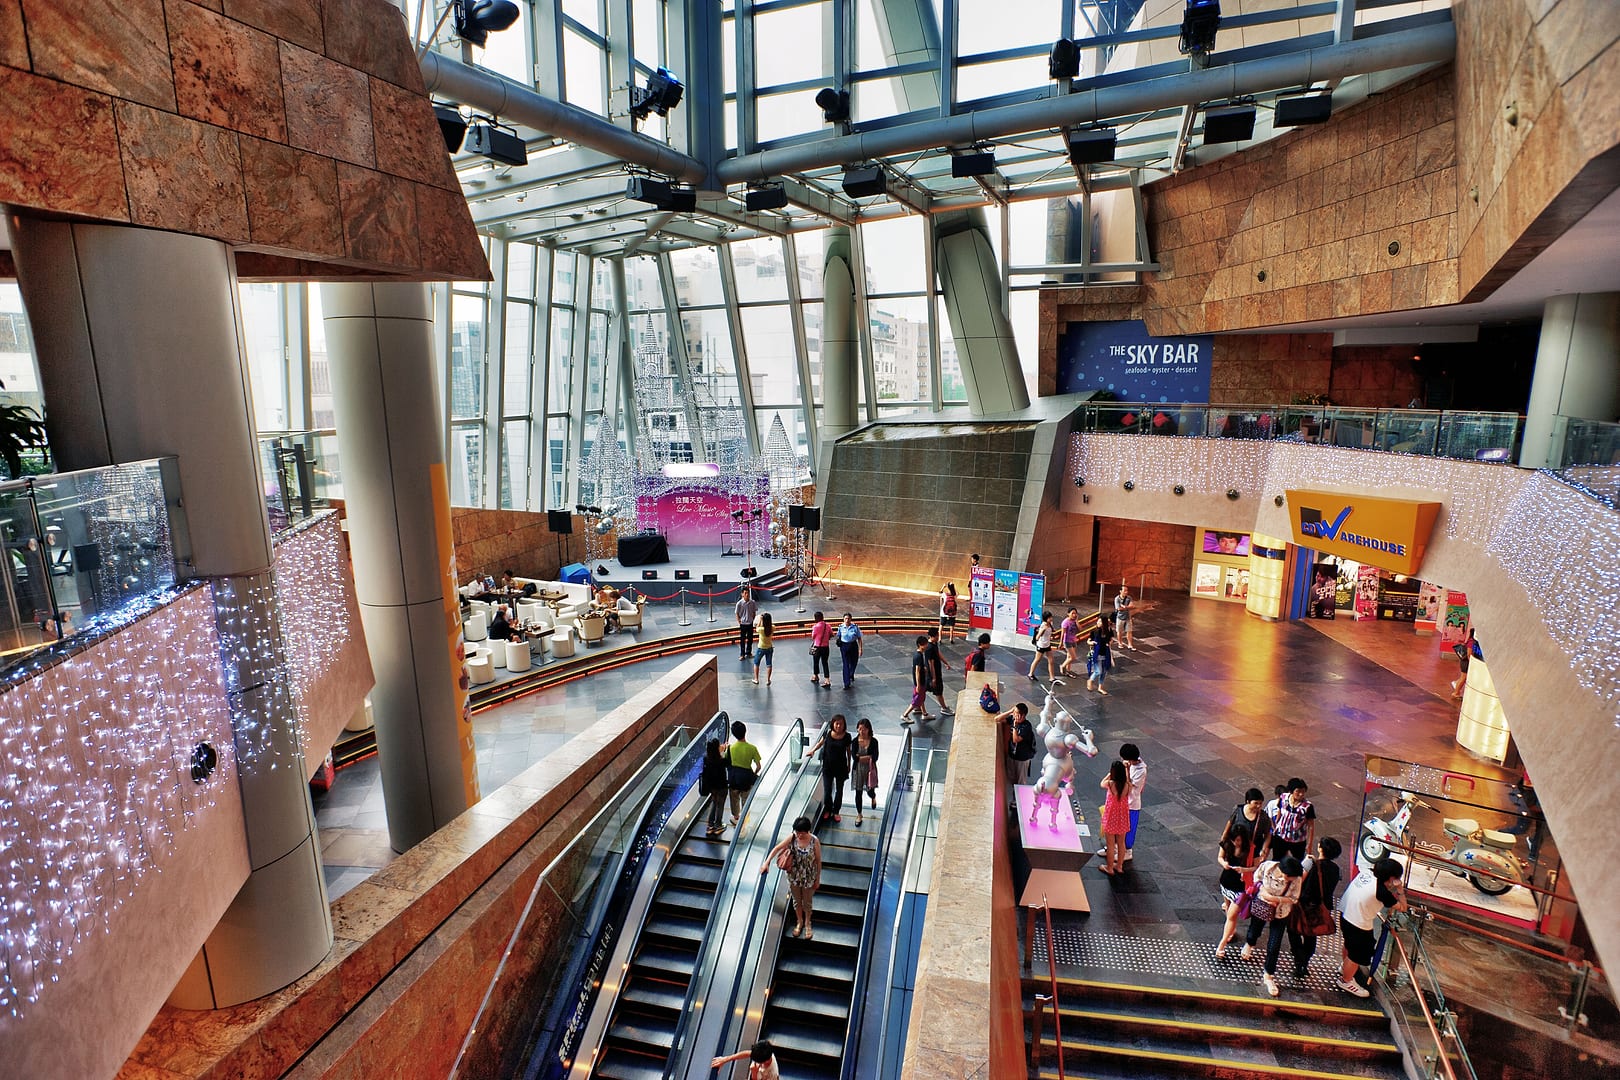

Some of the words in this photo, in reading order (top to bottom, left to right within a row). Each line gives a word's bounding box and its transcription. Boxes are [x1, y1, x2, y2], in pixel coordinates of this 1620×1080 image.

[1109, 345, 1126, 356] THE
[1126, 345, 1159, 365] SKY
[1162, 343, 1199, 364] BAR
[1125, 366, 1148, 374] seafood
[1152, 366, 1170, 375] oyster
